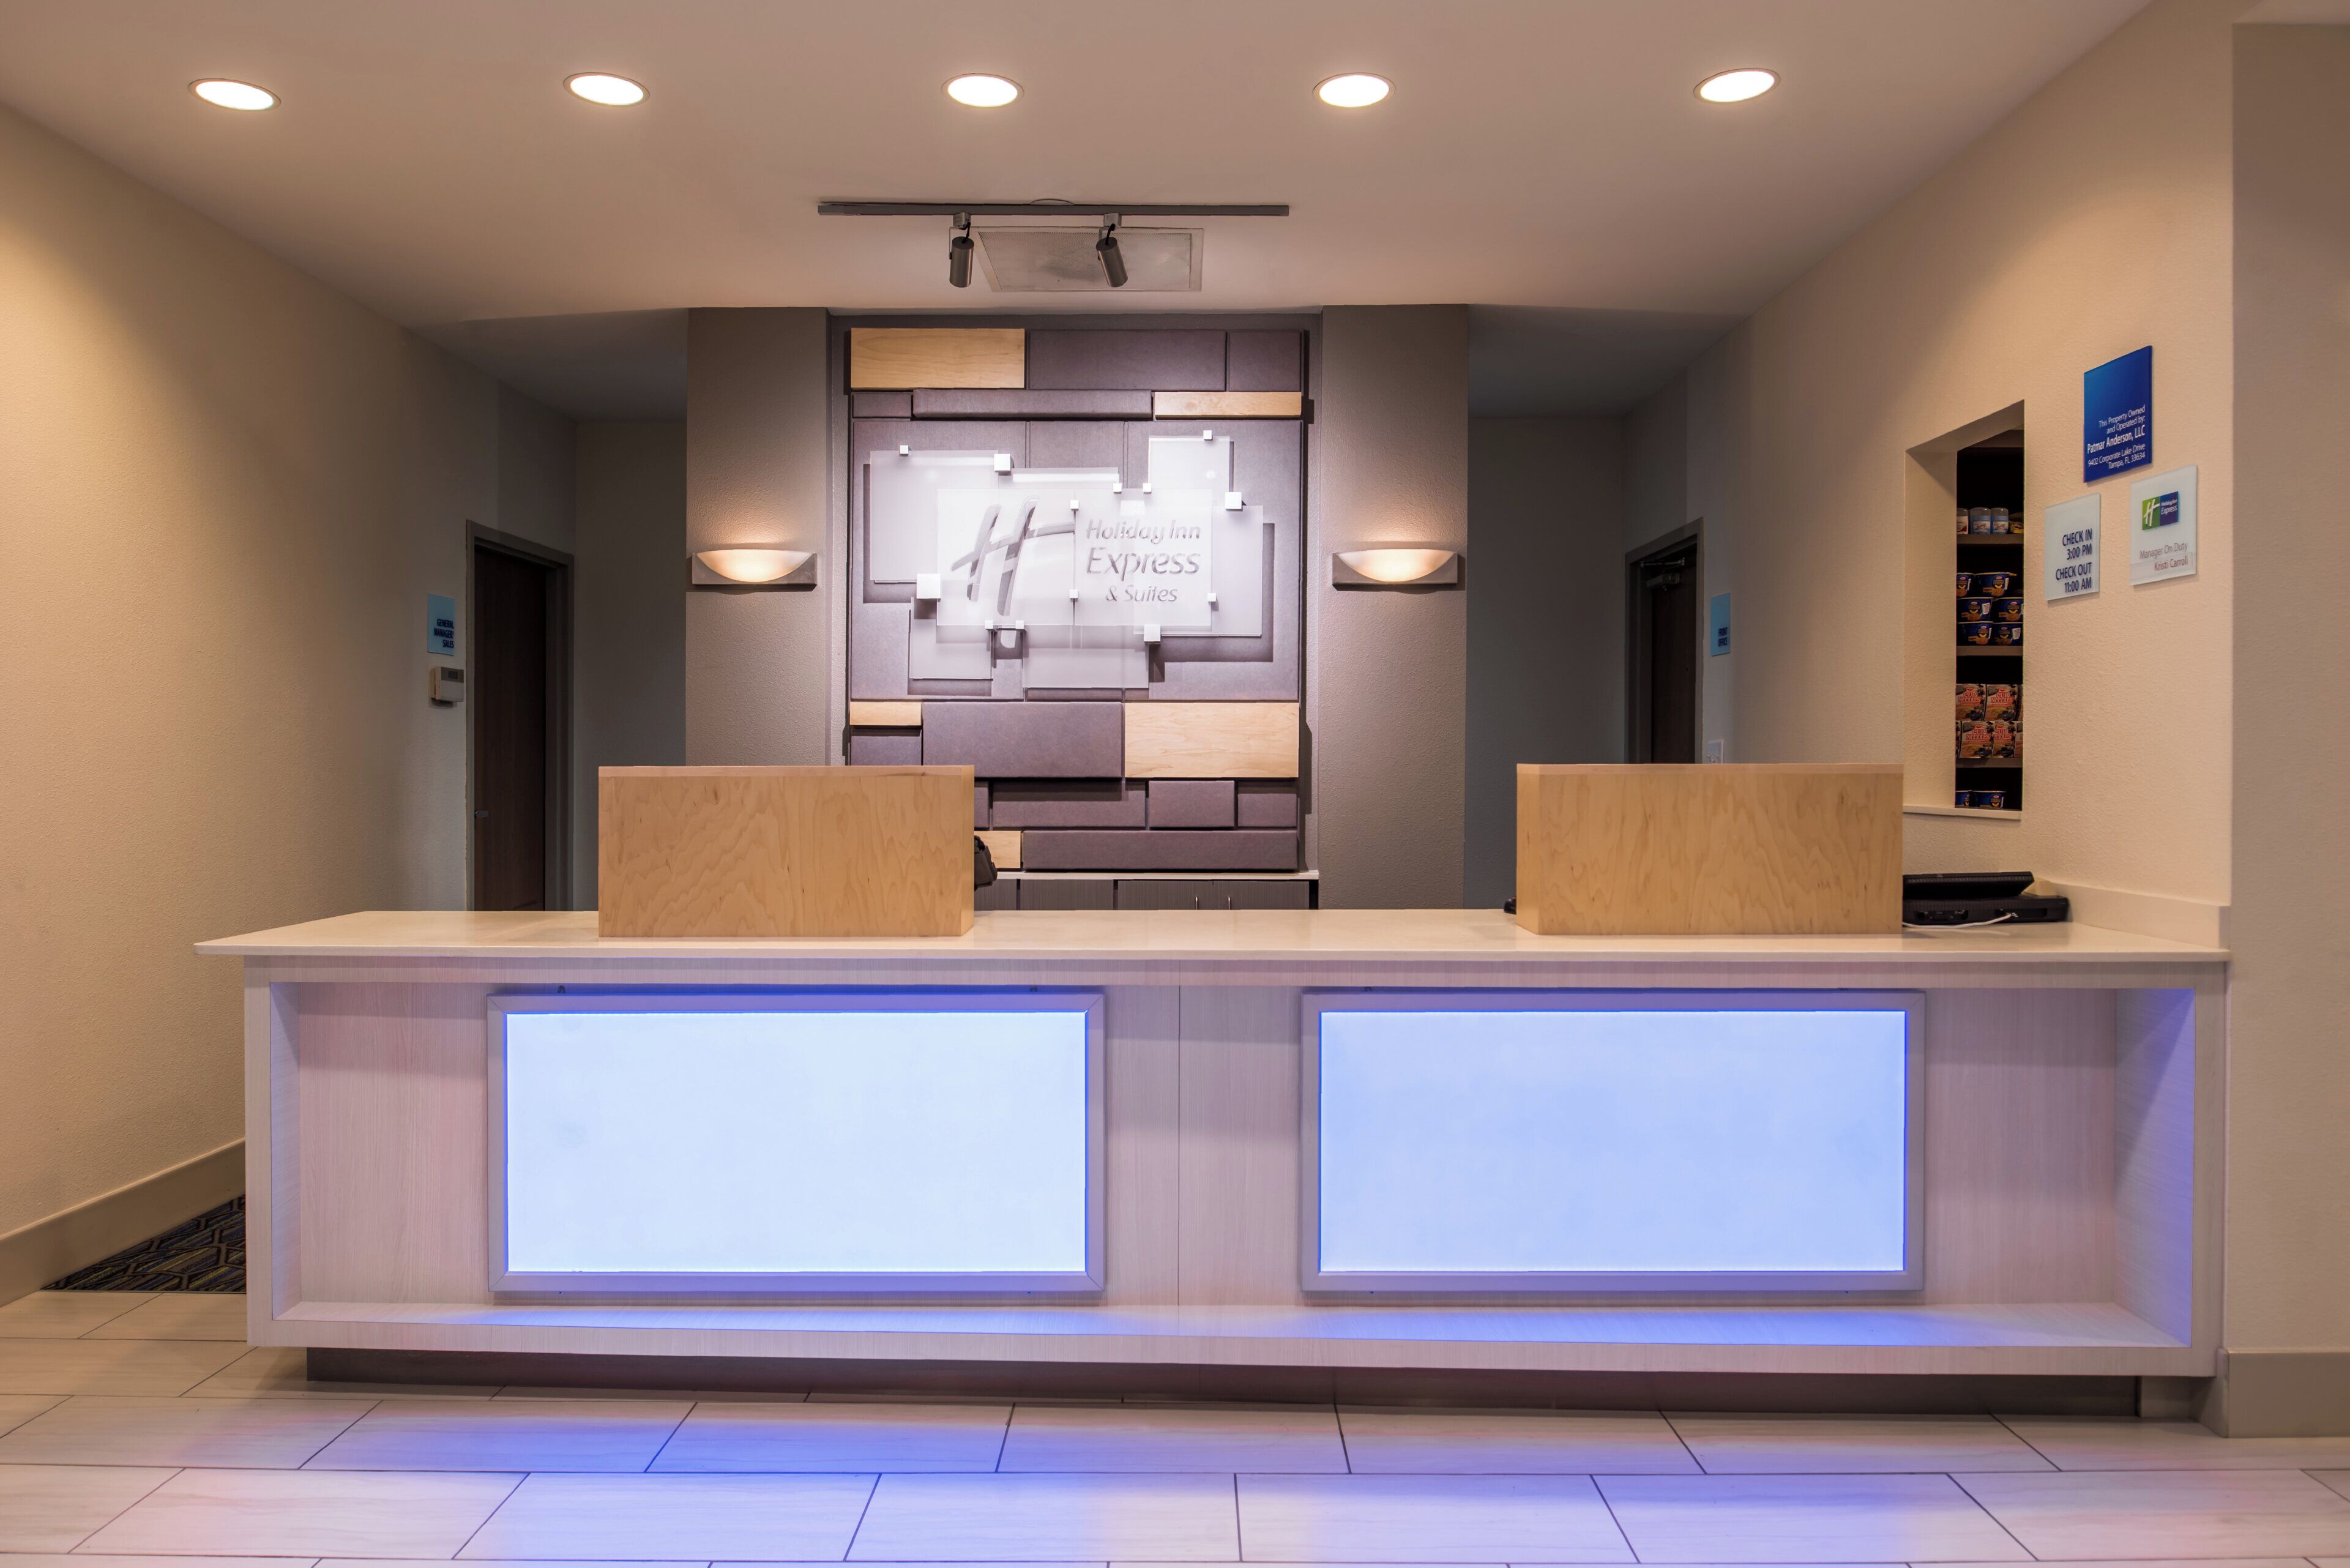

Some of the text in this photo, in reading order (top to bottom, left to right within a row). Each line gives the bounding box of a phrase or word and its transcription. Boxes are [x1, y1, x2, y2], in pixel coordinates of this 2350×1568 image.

[2108, 413, 2127, 424] Property
[2128, 405, 2145, 417] Owned
[2116, 419, 2136, 431] Operated
[2087, 425, 2145, 454] Patmar Anderson, LLC
[2088, 444, 2145, 467] 9402 Corporate Lake Drive
[2108, 460, 2124, 469] Tampa,
[2131, 452, 2145, 463] 33634
[2161, 506, 2177, 515] Express
[1087, 519, 1201, 544] Holiday Inn
[2062, 528, 2092, 546] CHECK IN
[2067, 543, 2092, 560] 3:00 PM
[2139, 542, 2188, 559] Manager On Duty
[1087, 547, 1201, 581] Express
[2056, 562, 2092, 580] CHECK OUT
[2154, 555, 2188, 571] Kristi Carroll
[1106, 584, 1178, 602] & Suites
[2064, 577, 2092, 592] 11:00 AM
[437, 619, 455, 629] GENERAL
[442, 640, 455, 648] SALES
